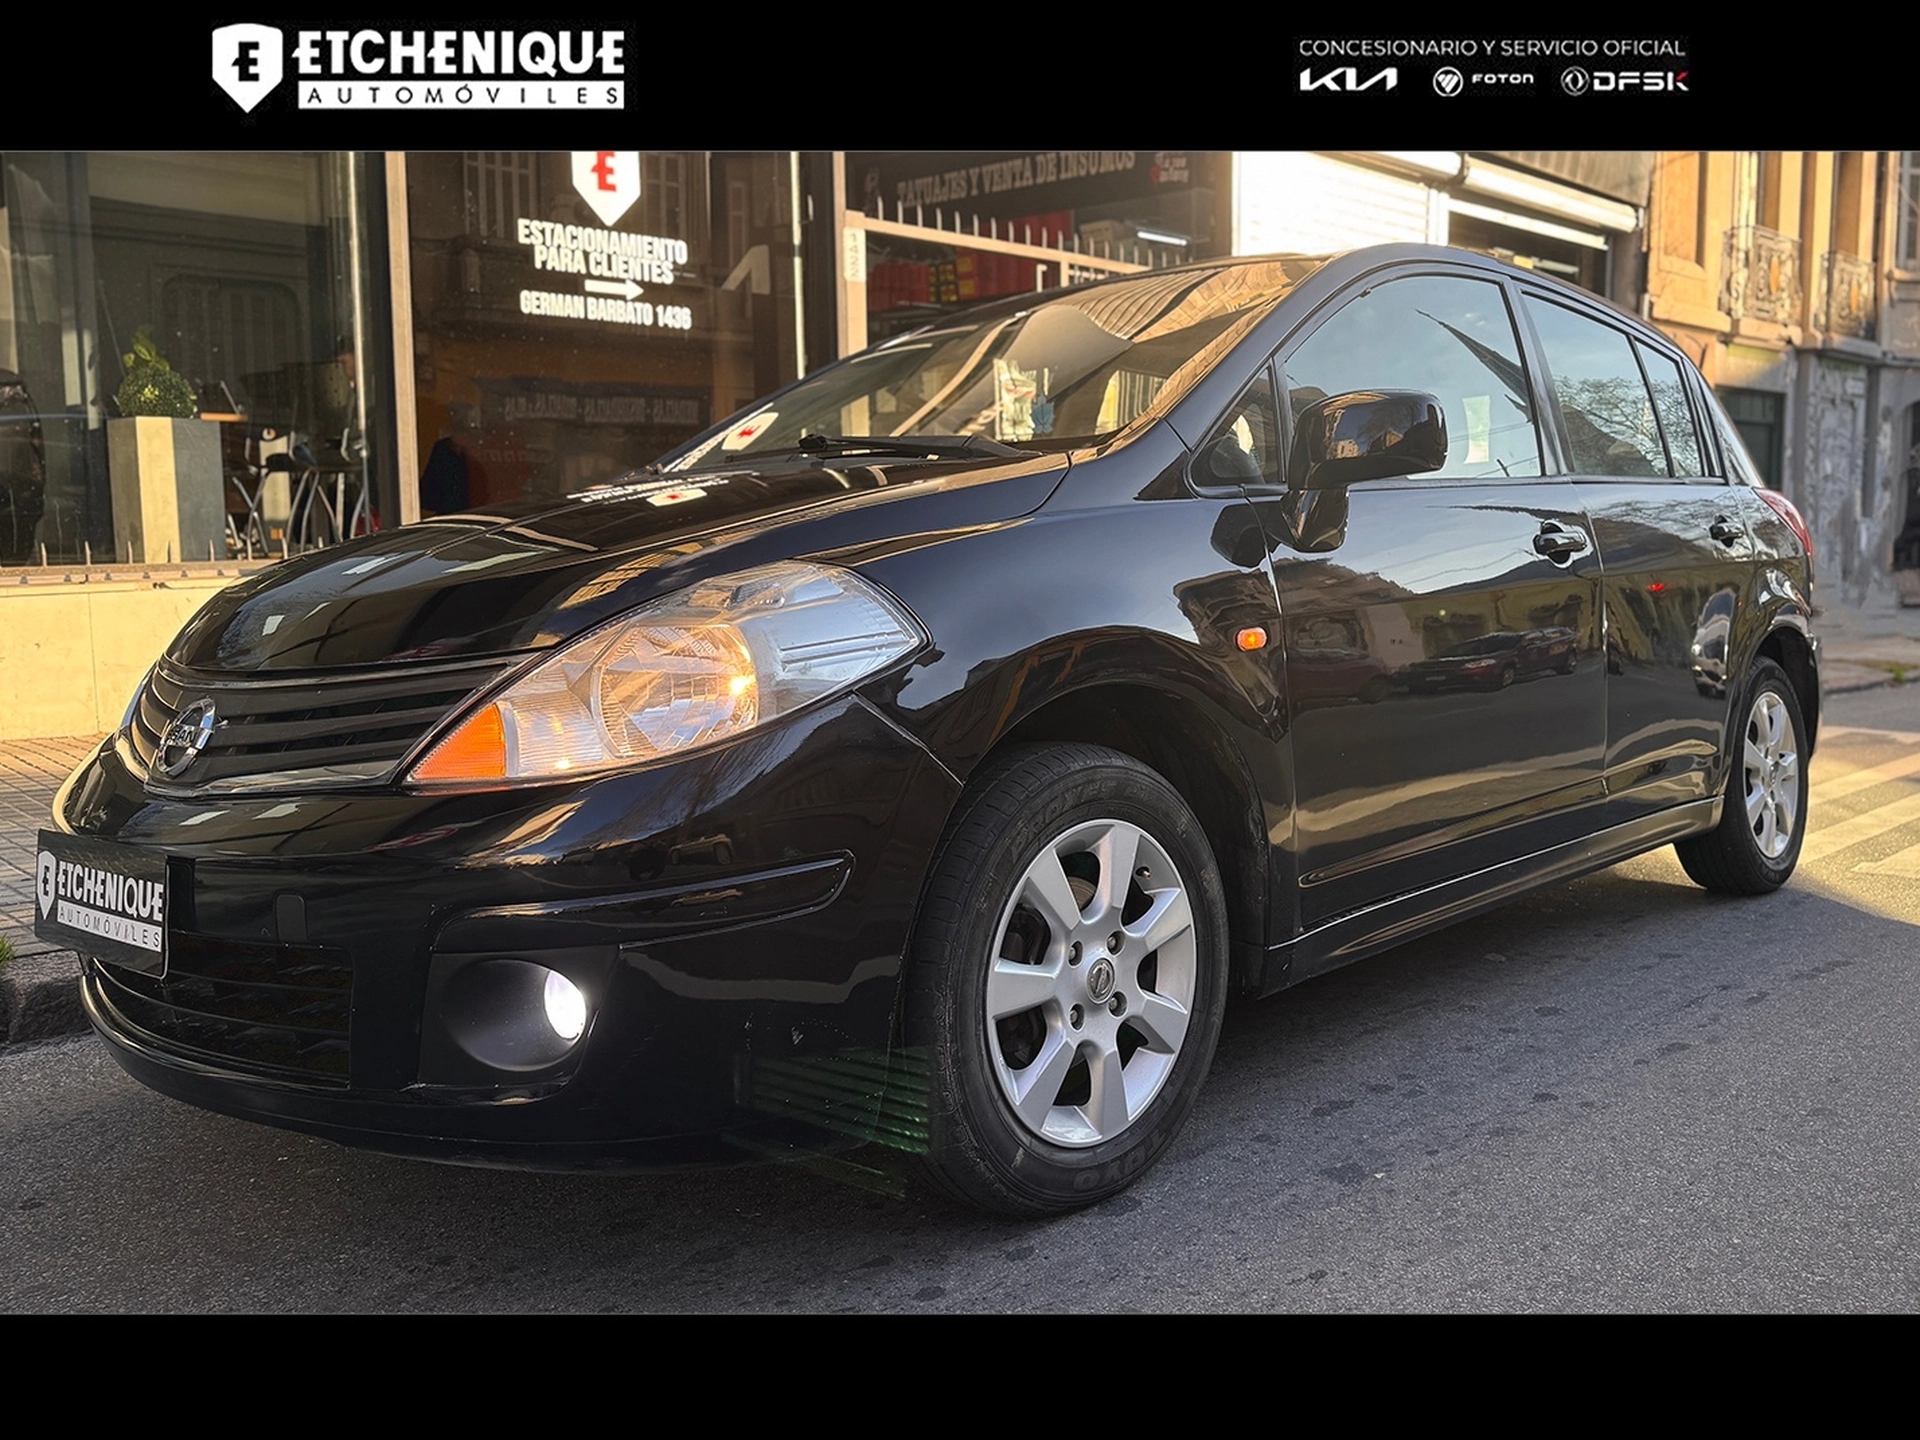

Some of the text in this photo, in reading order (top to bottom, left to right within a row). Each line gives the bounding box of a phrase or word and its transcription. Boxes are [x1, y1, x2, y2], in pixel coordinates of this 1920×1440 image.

[897, 168, 968, 209] TATUAJES
[969, 167, 981, 197] Y
[981, 156, 1034, 194] VENTA
[1035, 153, 1058, 185] DE
[1058, 151, 1136, 180] INSUMOS
[517, 218, 688, 265] ESTACIONAMIENTO
[534, 244, 675, 285] PARA CLIENTES
[520, 289, 585, 319] GERMAN
[586, 296, 653, 326] BARBATO
[57, 860, 164, 922] ETCHENIQUE
[59, 906, 160, 948] AUTOMÓVILES
